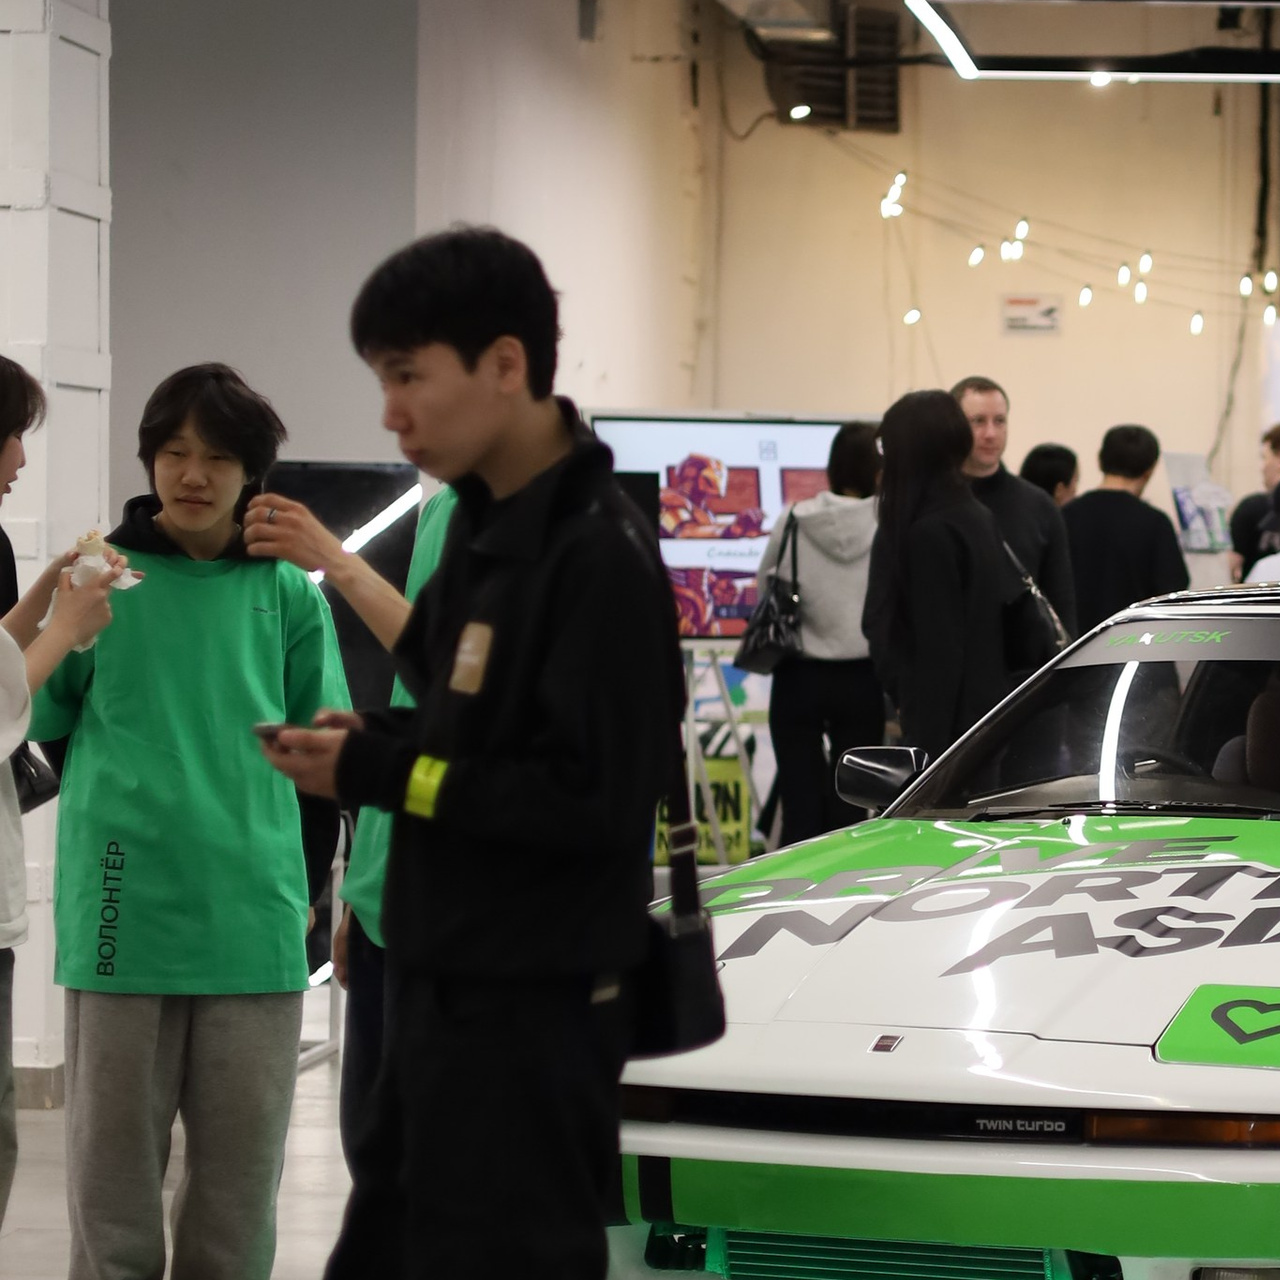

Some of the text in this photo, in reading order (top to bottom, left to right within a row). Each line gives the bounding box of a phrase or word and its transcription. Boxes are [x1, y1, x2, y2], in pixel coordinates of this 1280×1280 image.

[97, 841, 125, 976] ВОЛОНТЁР
[975, 1119, 1066, 1132] TWIN turbo
